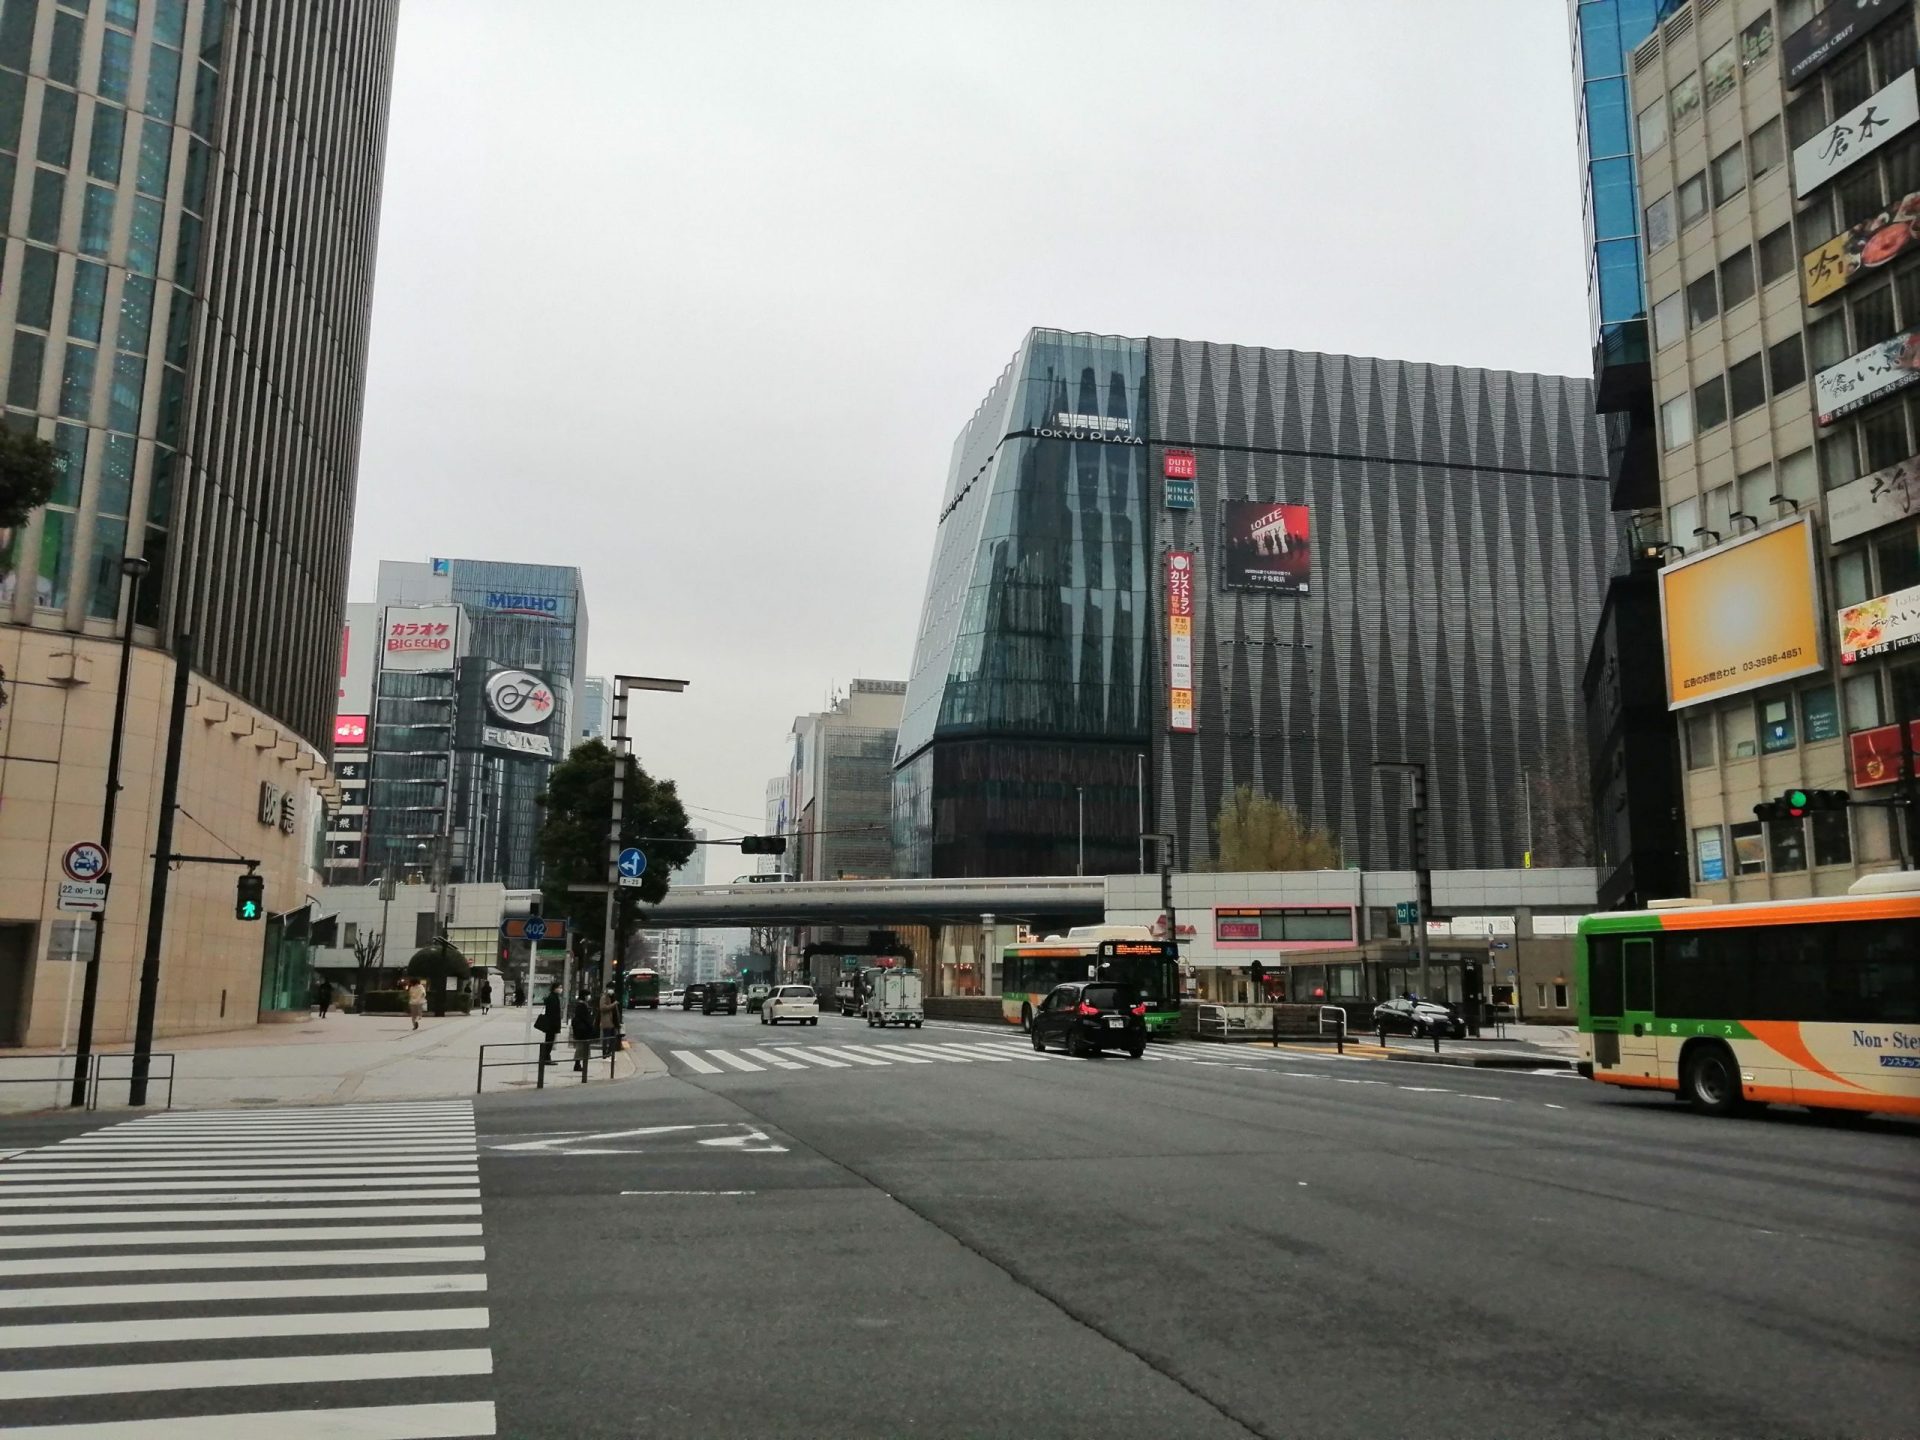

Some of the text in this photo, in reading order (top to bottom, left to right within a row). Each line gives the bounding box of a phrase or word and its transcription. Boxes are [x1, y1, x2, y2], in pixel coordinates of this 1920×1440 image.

[1791, 23, 1855, 76] UNIVERSAL CRAFT
[1031, 427, 1144, 445] TOKYU PLAZA
[1168, 458, 1193, 467] DUTY
[1168, 466, 1193, 475] FREE
[1250, 507, 1283, 531] LOTTE
[1170, 571, 1180, 595] カフェ
[487, 593, 557, 611] MIZUHO
[1180, 571, 1190, 615] レストラン
[391, 622, 450, 638] カラオケ
[1174, 623, 1188, 631] 7:30
[387, 638, 451, 651] BIG ECHO
[260, 781, 295, 834] 阪急
[525, 924, 545, 935] 402
